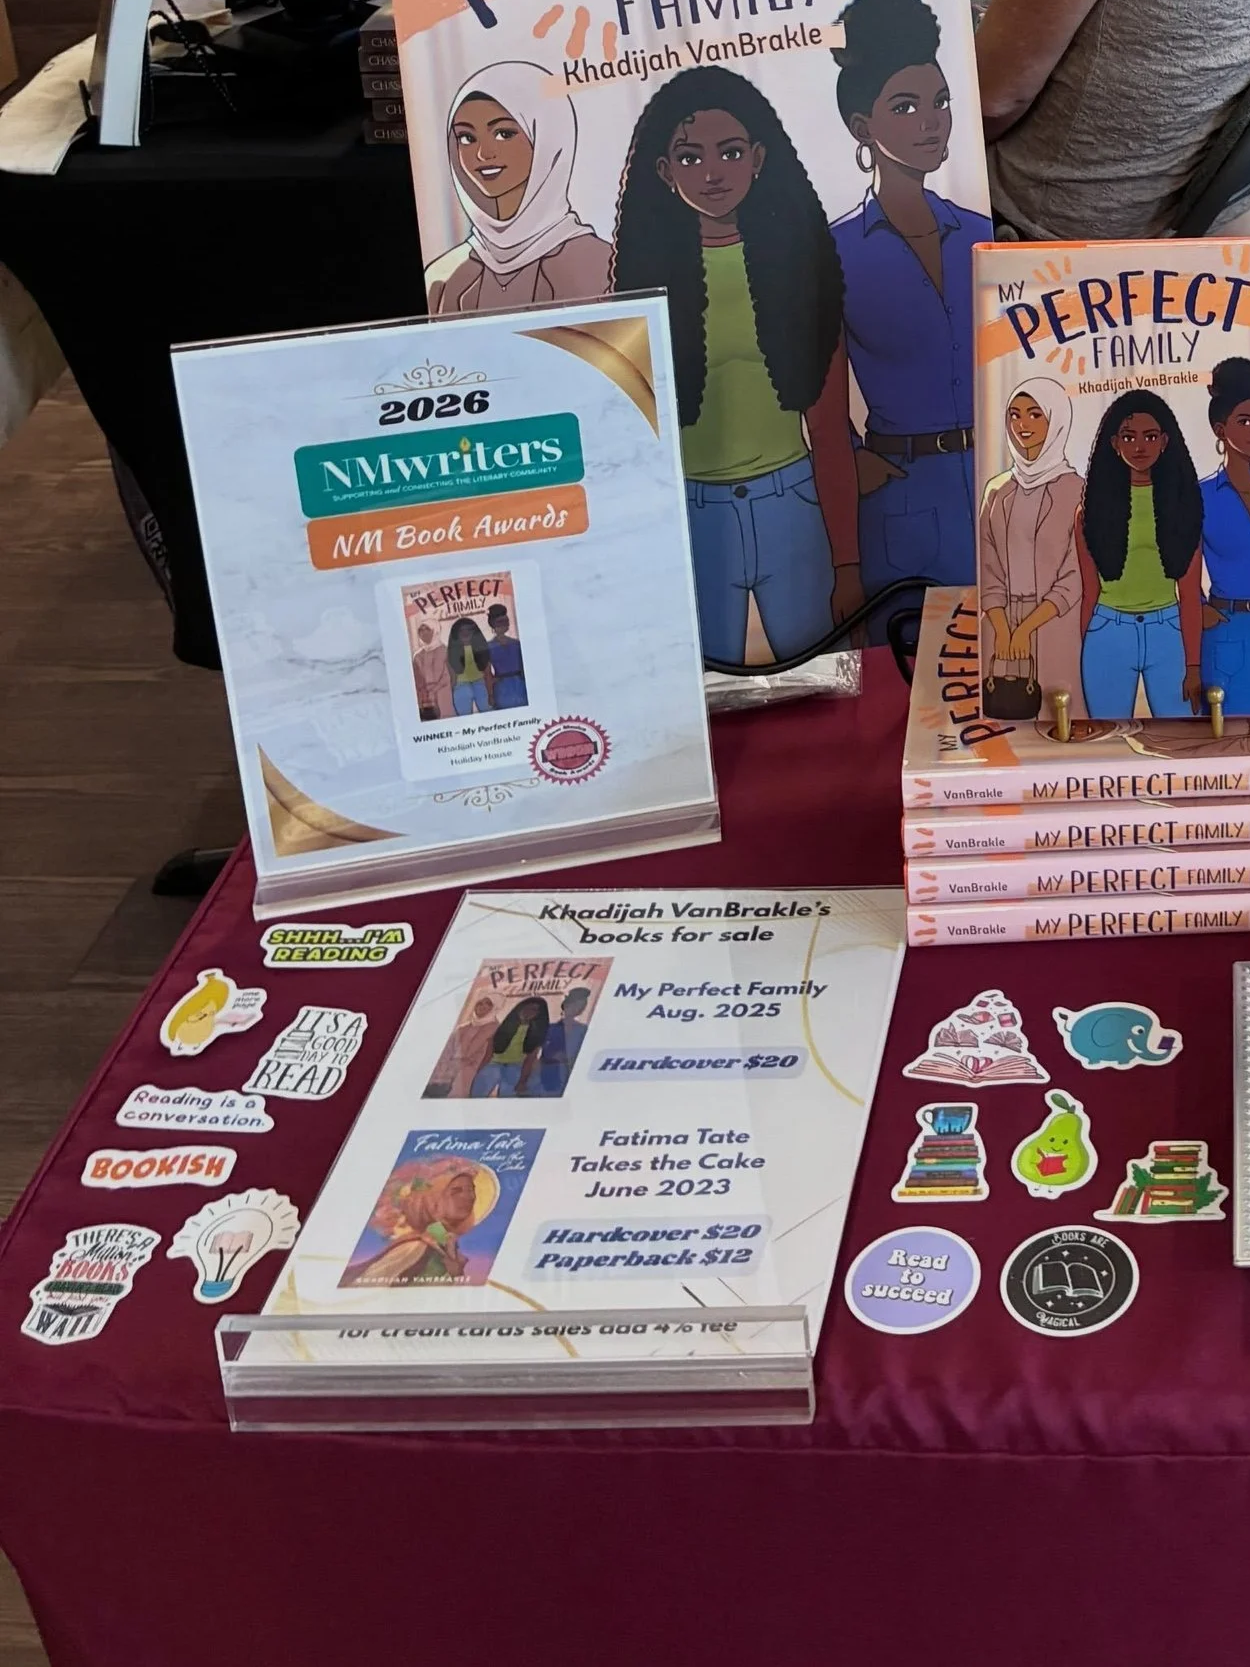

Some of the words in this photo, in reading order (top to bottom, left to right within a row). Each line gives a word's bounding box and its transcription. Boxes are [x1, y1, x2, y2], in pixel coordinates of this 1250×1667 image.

[562, 47, 682, 86] Khadijah
[687, 22, 823, 70] VanBrakle
[998, 280, 1025, 303] MY
[1092, 330, 1200, 369] FAMILY
[1078, 377, 1133, 395] Khadijah
[1135, 372, 1199, 389] VanBrakle
[378, 390, 490, 426] 2026
[319, 437, 563, 492] NMwriters
[332, 488, 383, 502] SUPPORTING
[384, 485, 401, 495] and
[402, 479, 454, 492] CONNECTING
[456, 477, 471, 485] THE
[472, 473, 509, 484] LITERARY
[509, 466, 558, 478] COMMUNITY
[333, 529, 384, 560] NM
[396, 516, 464, 550] Book
[473, 503, 568, 539] Awards
[414, 579, 504, 614] PERFECT
[413, 731, 453, 743] WINNER
[462, 727, 476, 738] My
[478, 722, 511, 733] Perfect
[513, 717, 542, 730] Family
[945, 837, 1006, 849] VanBrakle
[1034, 830, 1061, 847] MY
[1068, 821, 1178, 848] PERFECT
[1185, 822, 1244, 840] FAMILY
[538, 901, 664, 924] Khadijah
[671, 899, 831, 920] VanBrakle's
[579, 925, 663, 945] books
[671, 925, 714, 944] for
[720, 925, 775, 943] sale
[271, 947, 387, 962] READING
[614, 982, 652, 1001] My
[659, 979, 744, 1000] Perfect
[747, 979, 828, 1001] Family
[295, 1009, 342, 1034] IT'S
[341, 1017, 363, 1037] A
[646, 1003, 702, 1023] Aug.
[710, 1002, 782, 1019] 2025
[311, 1035, 358, 1052] GOOD
[301, 1050, 332, 1064] DAY
[333, 1051, 350, 1065] TO
[598, 1052, 742, 1072] Hardcover
[743, 1051, 799, 1073] $20
[249, 1059, 345, 1096] READ
[133, 1090, 213, 1111] Reading
[220, 1095, 238, 1110] is
[244, 1099, 257, 1110] a
[123, 1109, 266, 1129] conversation.
[600, 1129, 690, 1147] Fatima
[695, 1129, 750, 1146] Tate
[90, 1152, 228, 1181] BOOKISH
[570, 1155, 645, 1174] Takes
[651, 1153, 688, 1172] the
[694, 1154, 766, 1171] Cake
[583, 1180, 650, 1201] June
[656, 1178, 732, 1197] 2023
[72, 1227, 142, 1248] THERE'S
[543, 1223, 699, 1245] Hardcover
[704, 1222, 762, 1242] $20
[1051, 1231, 1087, 1247] BOOKS
[1090, 1234, 1111, 1248] ARE
[55, 1259, 130, 1281] BOOKS
[536, 1247, 696, 1272] Paperback
[699, 1245, 752, 1267] $12
[887, 1248, 949, 1271] Read
[901, 1268, 925, 1286] to
[861, 1282, 953, 1306] succeed
[1036, 1310, 1081, 1327] MAGICAL
